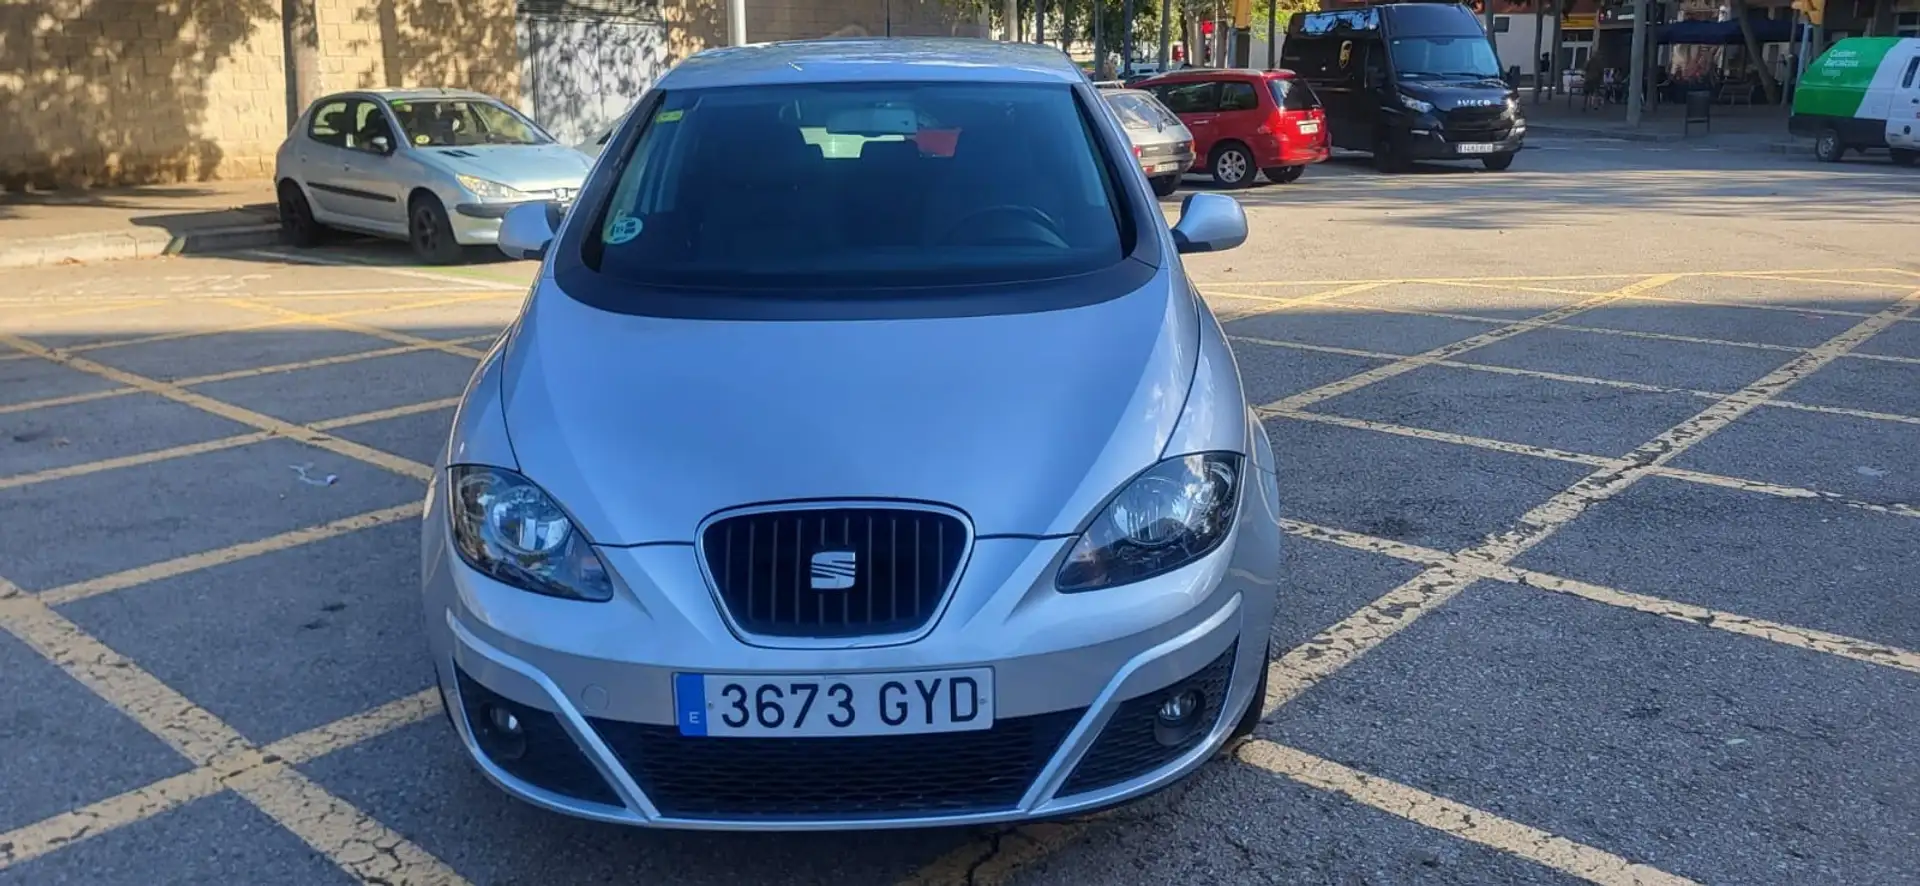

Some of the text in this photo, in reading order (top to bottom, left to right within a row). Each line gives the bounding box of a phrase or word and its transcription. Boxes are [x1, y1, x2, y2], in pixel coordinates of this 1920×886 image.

[1457, 99, 1491, 107] IVECO
[689, 677, 978, 728] E 3673 GYD
